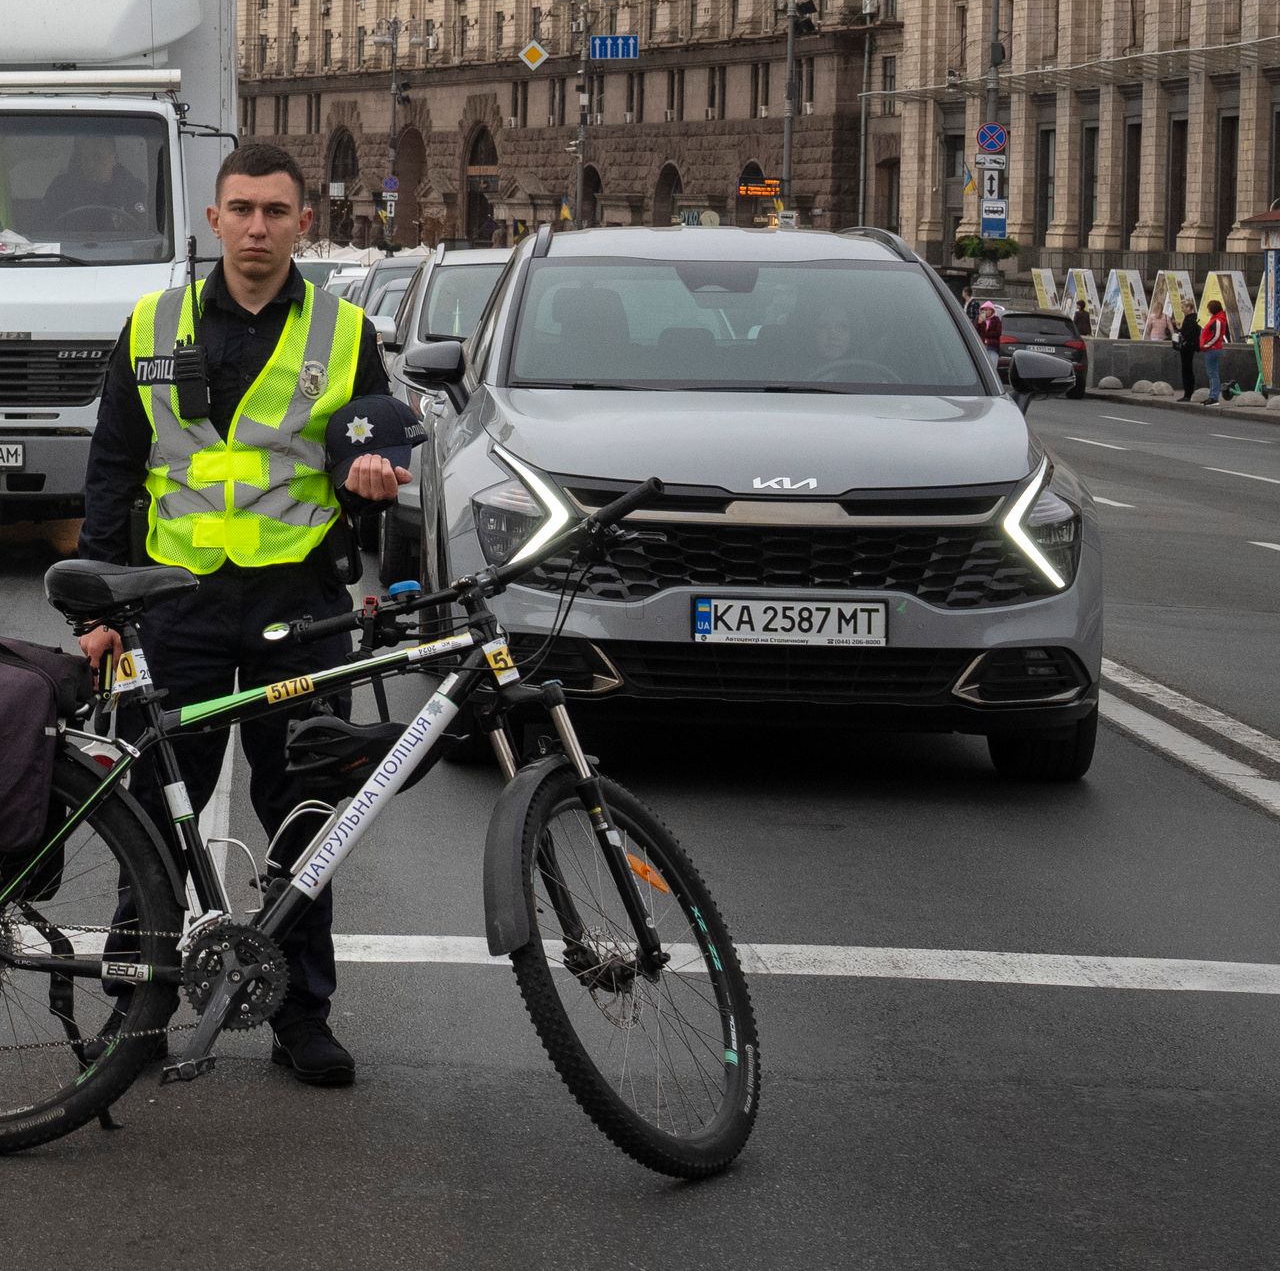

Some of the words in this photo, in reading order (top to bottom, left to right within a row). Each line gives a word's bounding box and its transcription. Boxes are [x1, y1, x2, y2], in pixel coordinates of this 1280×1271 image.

[58, 351, 88, 359] 814
[697, 622, 710, 630] UA
[713, 604, 755, 632] KA
[762, 606, 831, 634] 2587
[837, 607, 880, 634] MT
[492, 650, 511, 671] 5
[271, 677, 310, 701] 5170
[299, 790, 379, 889] ПАТРУЛЬНА
[373, 716, 432, 788] ПОЛІЦІЯ
